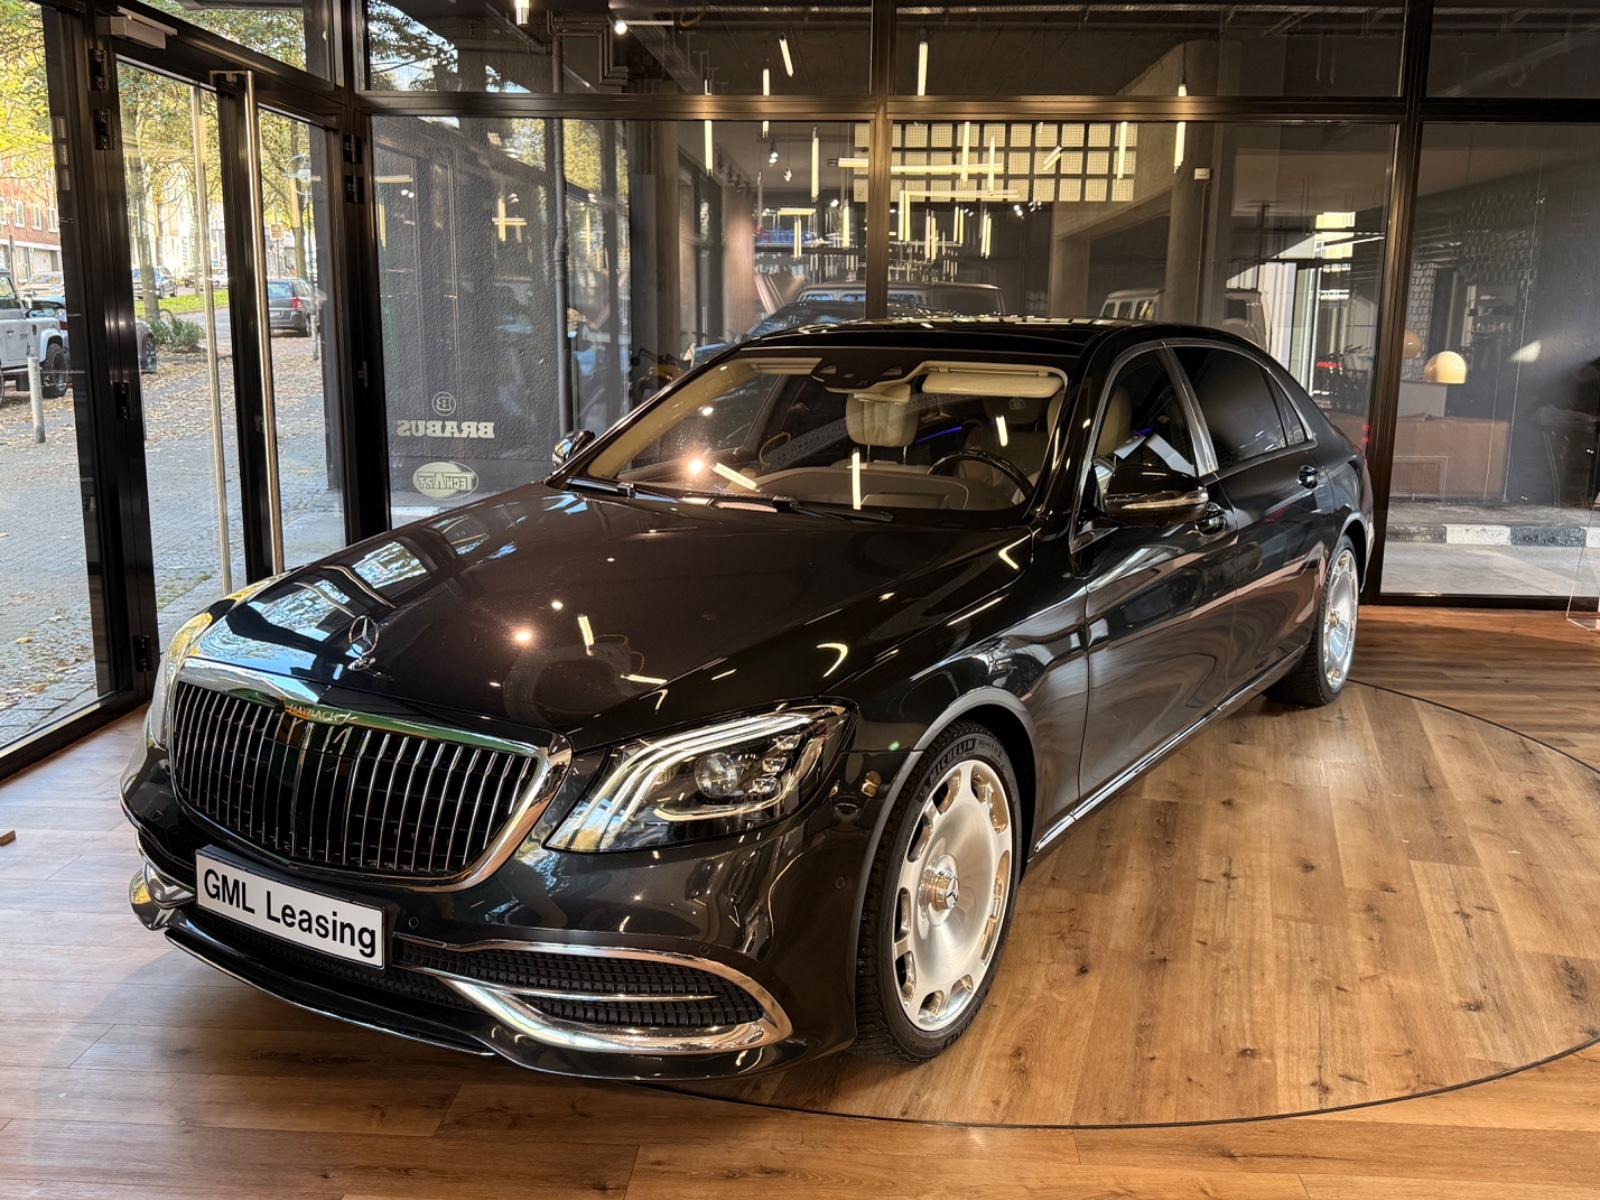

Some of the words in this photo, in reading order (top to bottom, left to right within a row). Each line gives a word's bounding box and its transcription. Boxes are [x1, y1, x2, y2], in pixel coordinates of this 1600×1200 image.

[929, 738, 976, 784] MICHELIN
[204, 869, 255, 914] GML
[266, 891, 376, 958] Leasing
